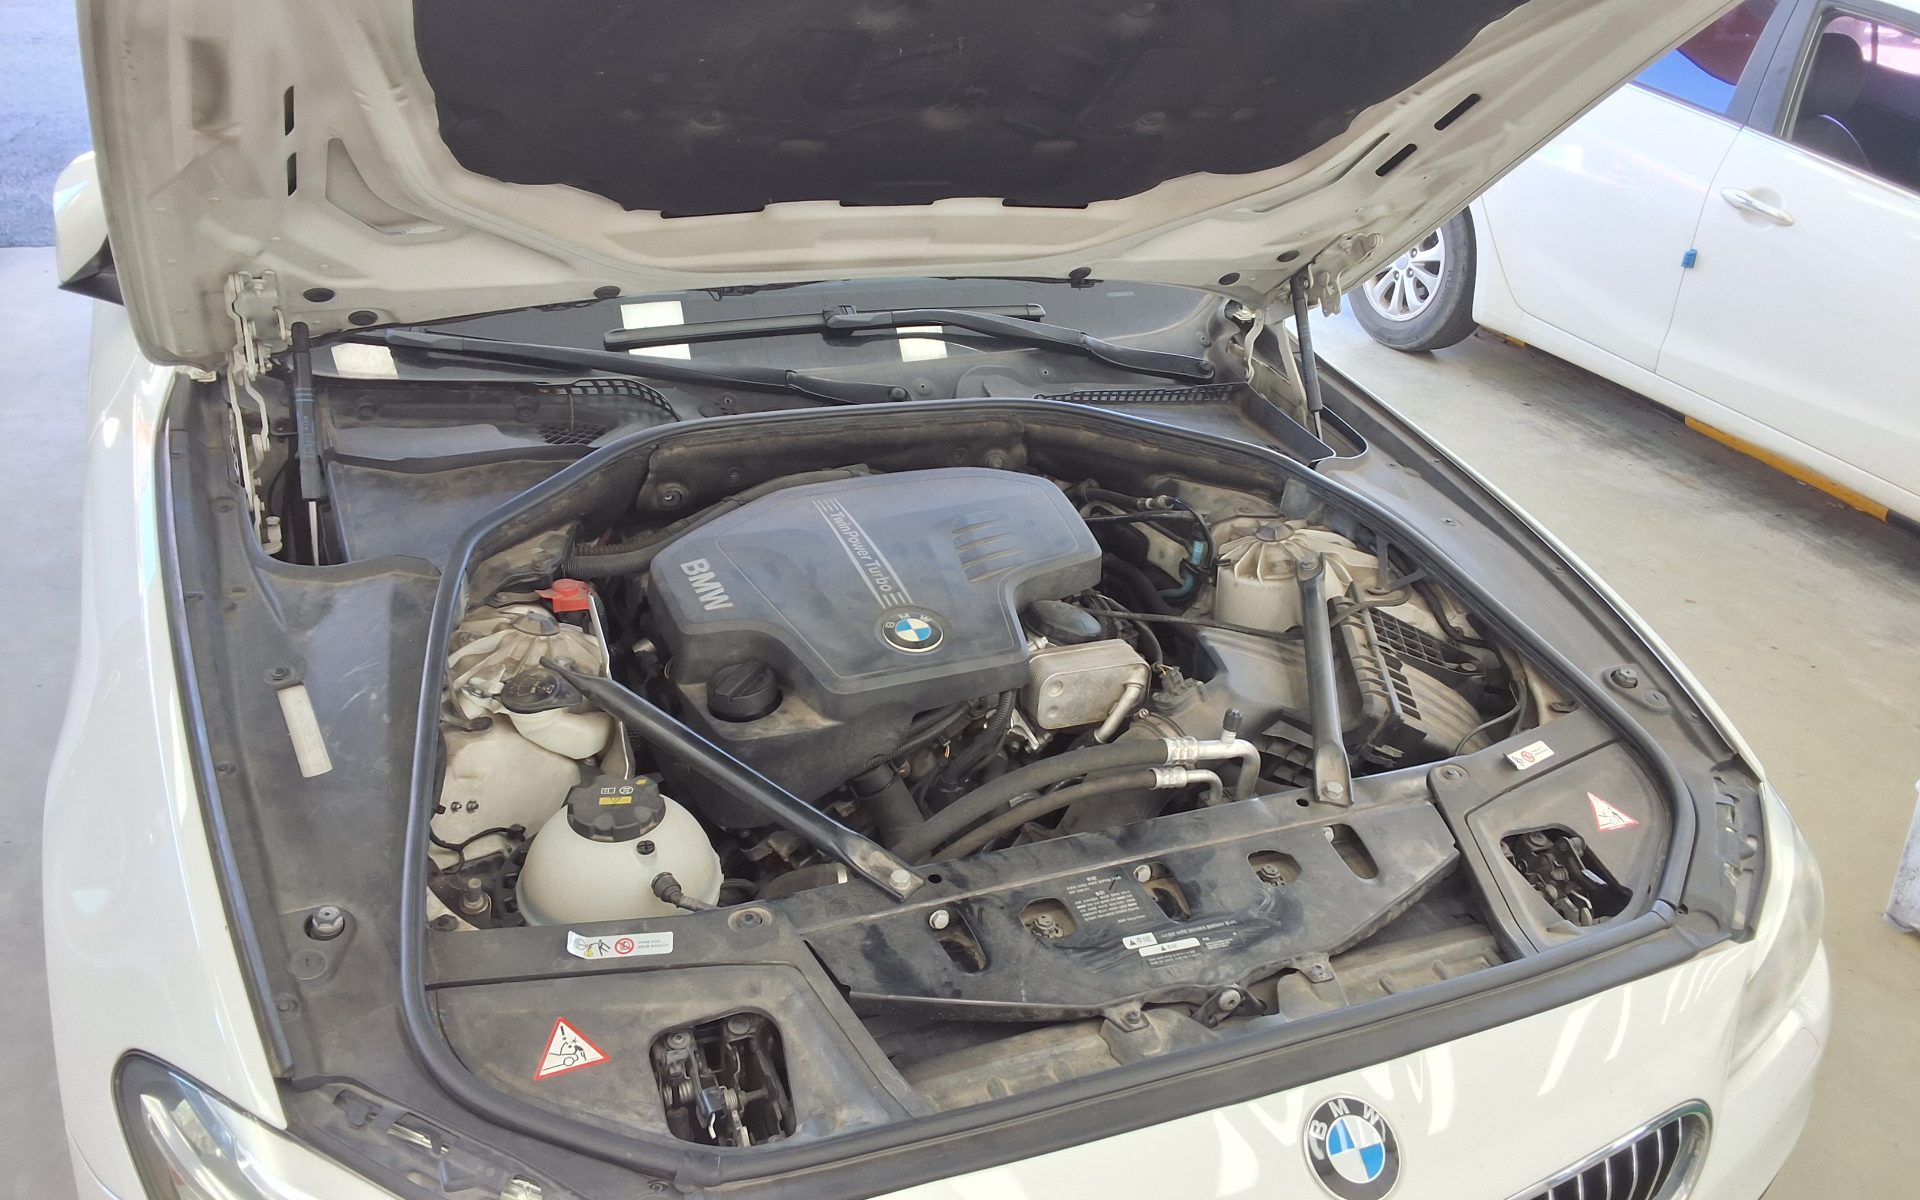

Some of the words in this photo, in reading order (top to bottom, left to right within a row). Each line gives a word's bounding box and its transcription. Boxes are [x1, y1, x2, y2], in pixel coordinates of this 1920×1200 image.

[830, 511, 873, 560] TwinPower
[865, 559, 892, 592] Turbo
[680, 558, 734, 610] BMW
[1308, 1098, 1381, 1141] BMW
